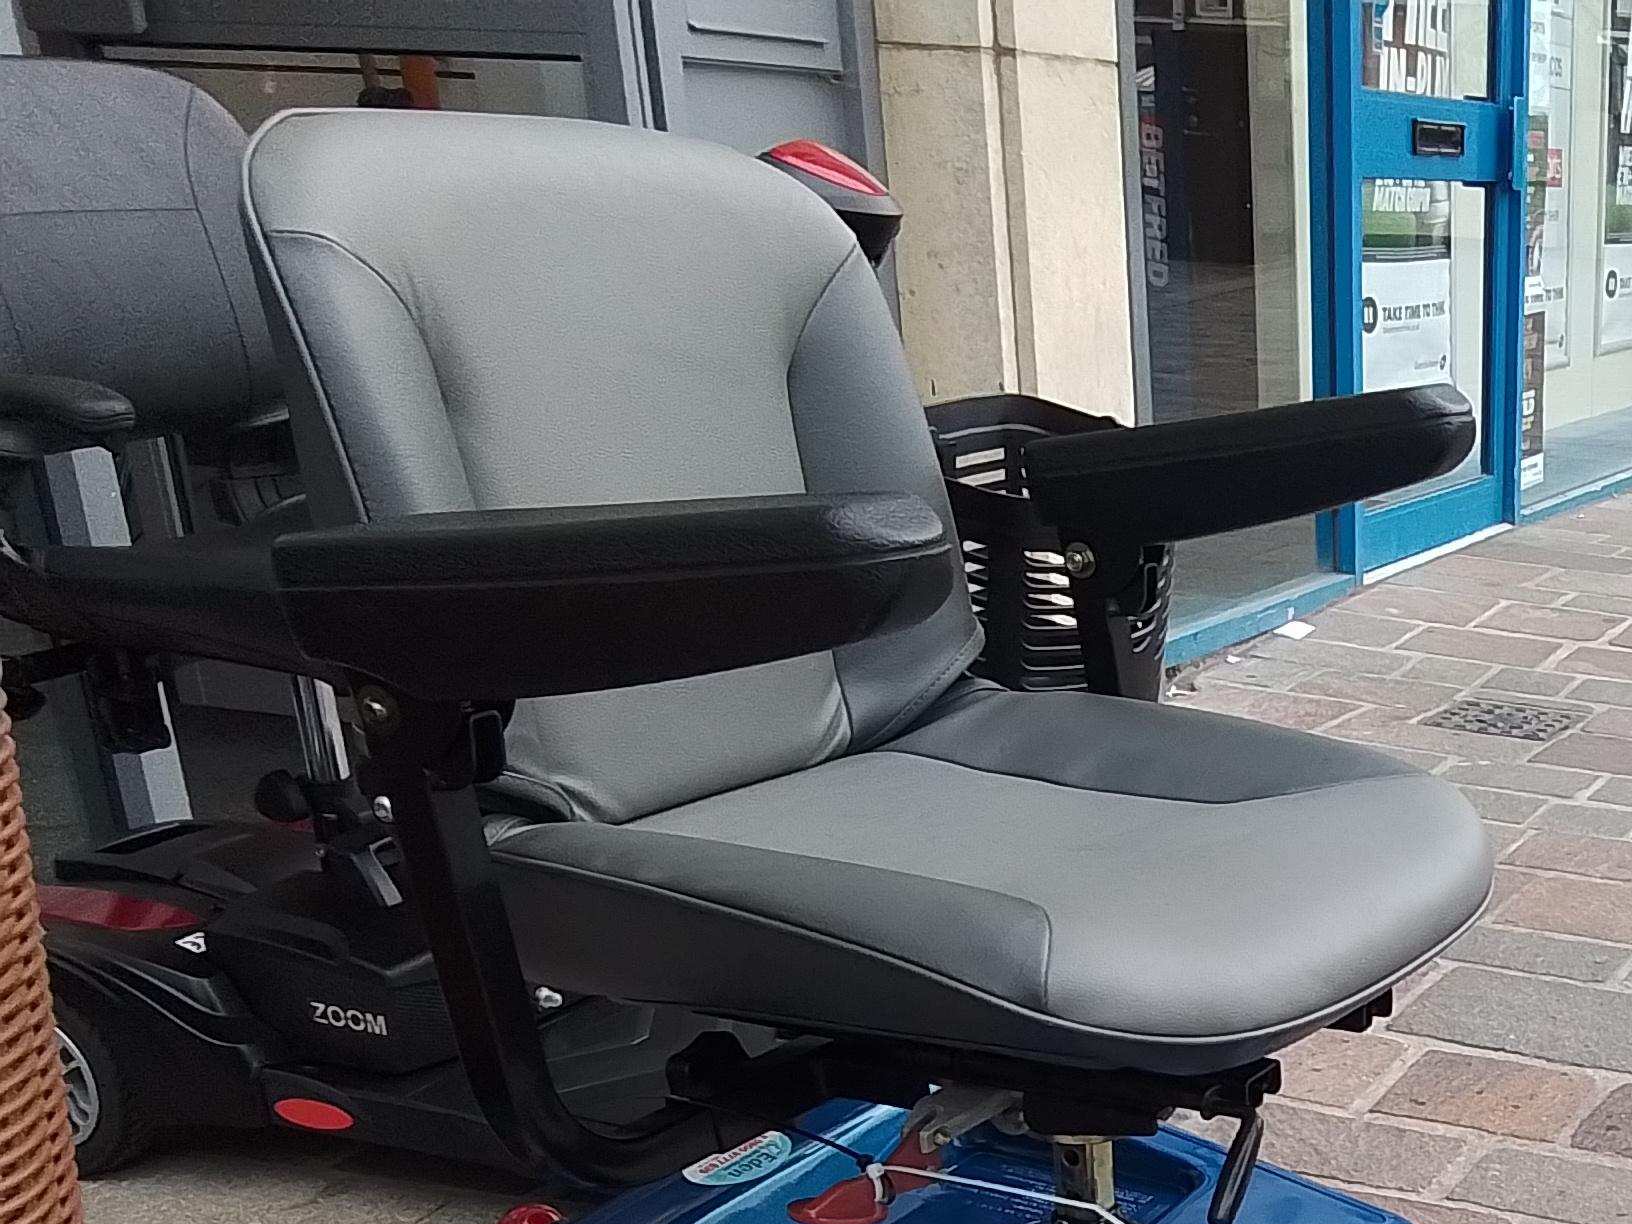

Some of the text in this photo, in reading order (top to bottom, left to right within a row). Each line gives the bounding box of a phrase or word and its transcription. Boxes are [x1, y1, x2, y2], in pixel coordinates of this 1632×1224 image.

[1141, 122, 1169, 287] BETFRED
[1382, 306, 1403, 321] TAKE
[310, 1002, 388, 1036] ZOOM
